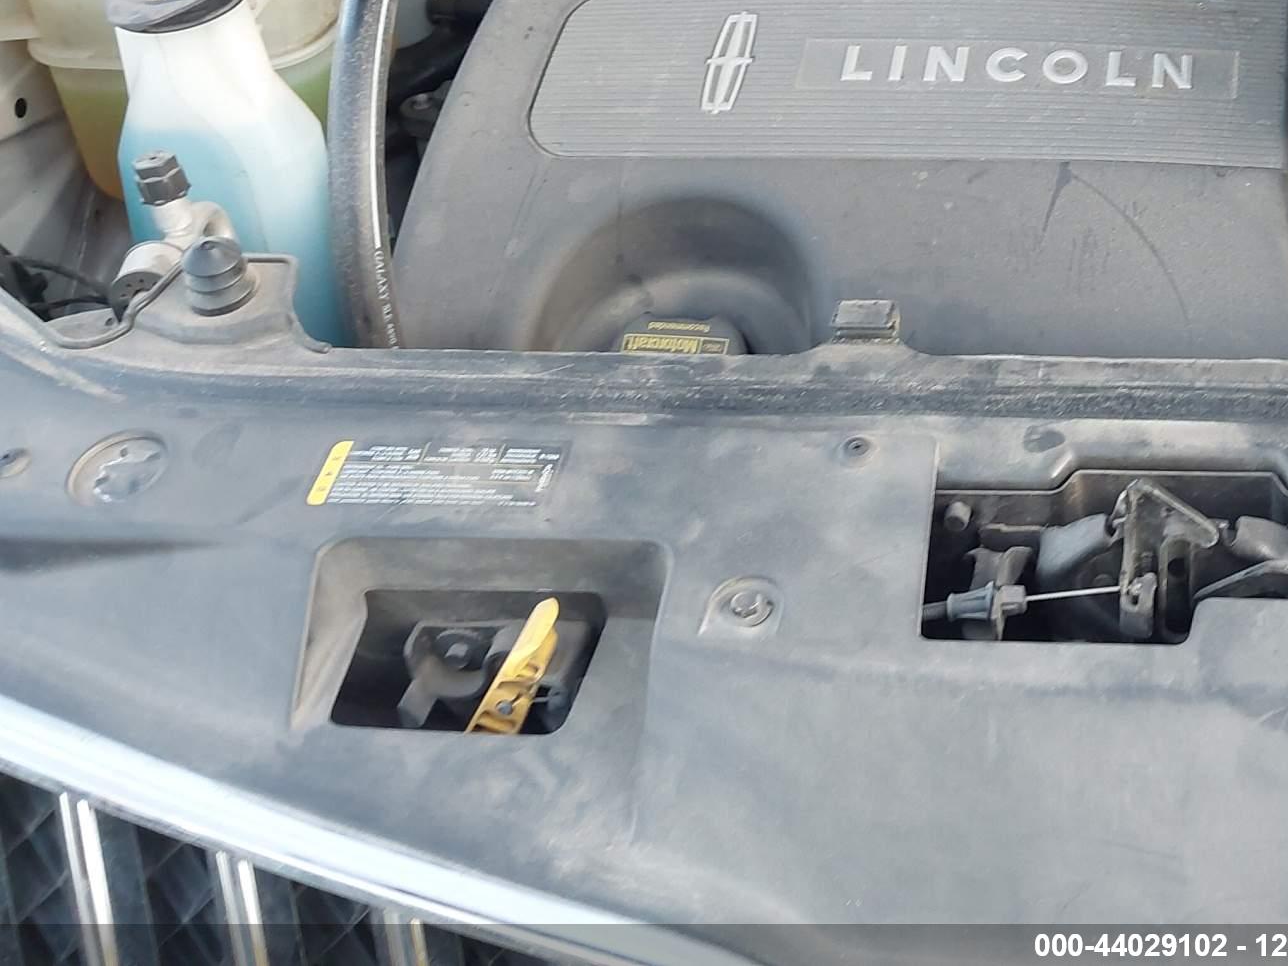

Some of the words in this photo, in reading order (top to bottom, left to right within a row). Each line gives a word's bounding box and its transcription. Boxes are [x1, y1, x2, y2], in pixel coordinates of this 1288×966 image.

[840, 44, 1194, 90] LINCOLN
[374, 250, 390, 300] GALAXY
[626, 337, 699, 354] Motorcraft
